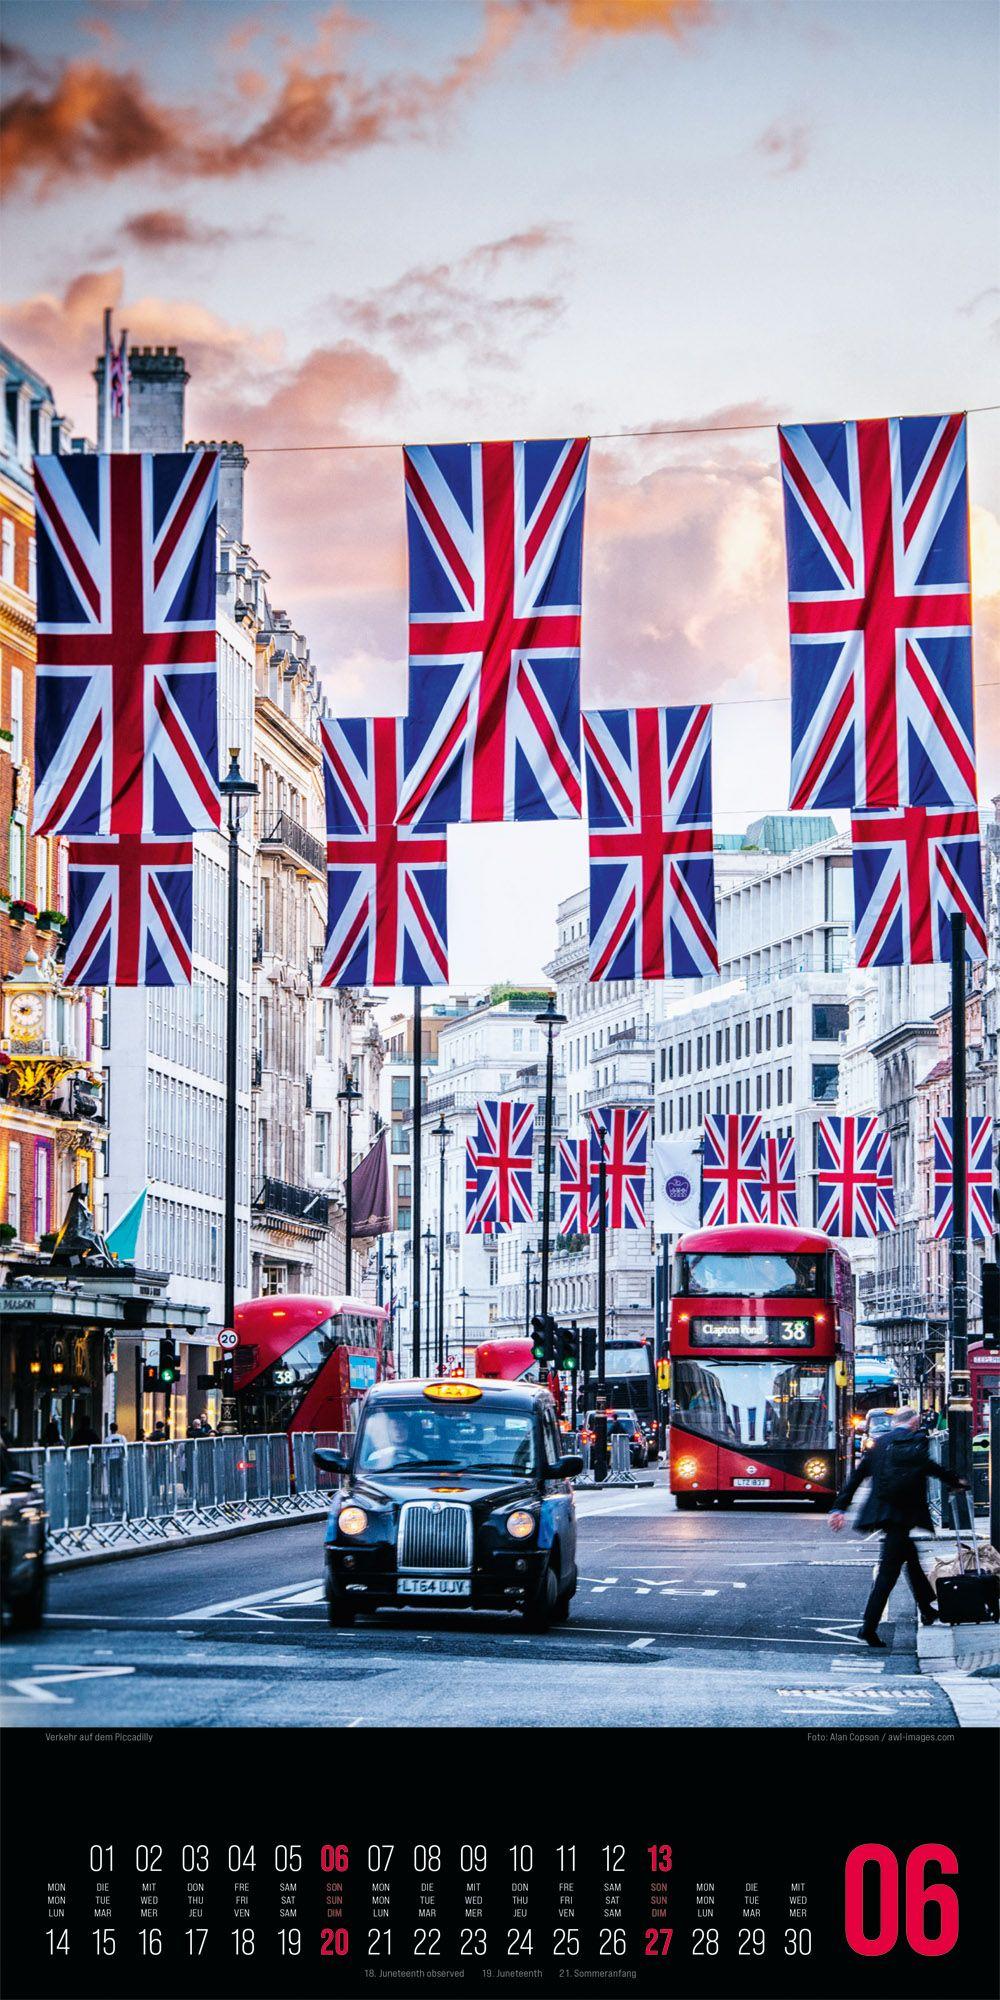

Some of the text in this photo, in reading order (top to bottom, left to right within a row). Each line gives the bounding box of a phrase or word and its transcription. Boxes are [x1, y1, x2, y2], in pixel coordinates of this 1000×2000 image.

[702, 1324, 740, 1337] Clapton
[781, 1321, 806, 1341] 38
[221, 1334, 237, 1344] 20
[274, 1370, 294, 1385] 38
[402, 1580, 465, 1593] LT64 UJV
